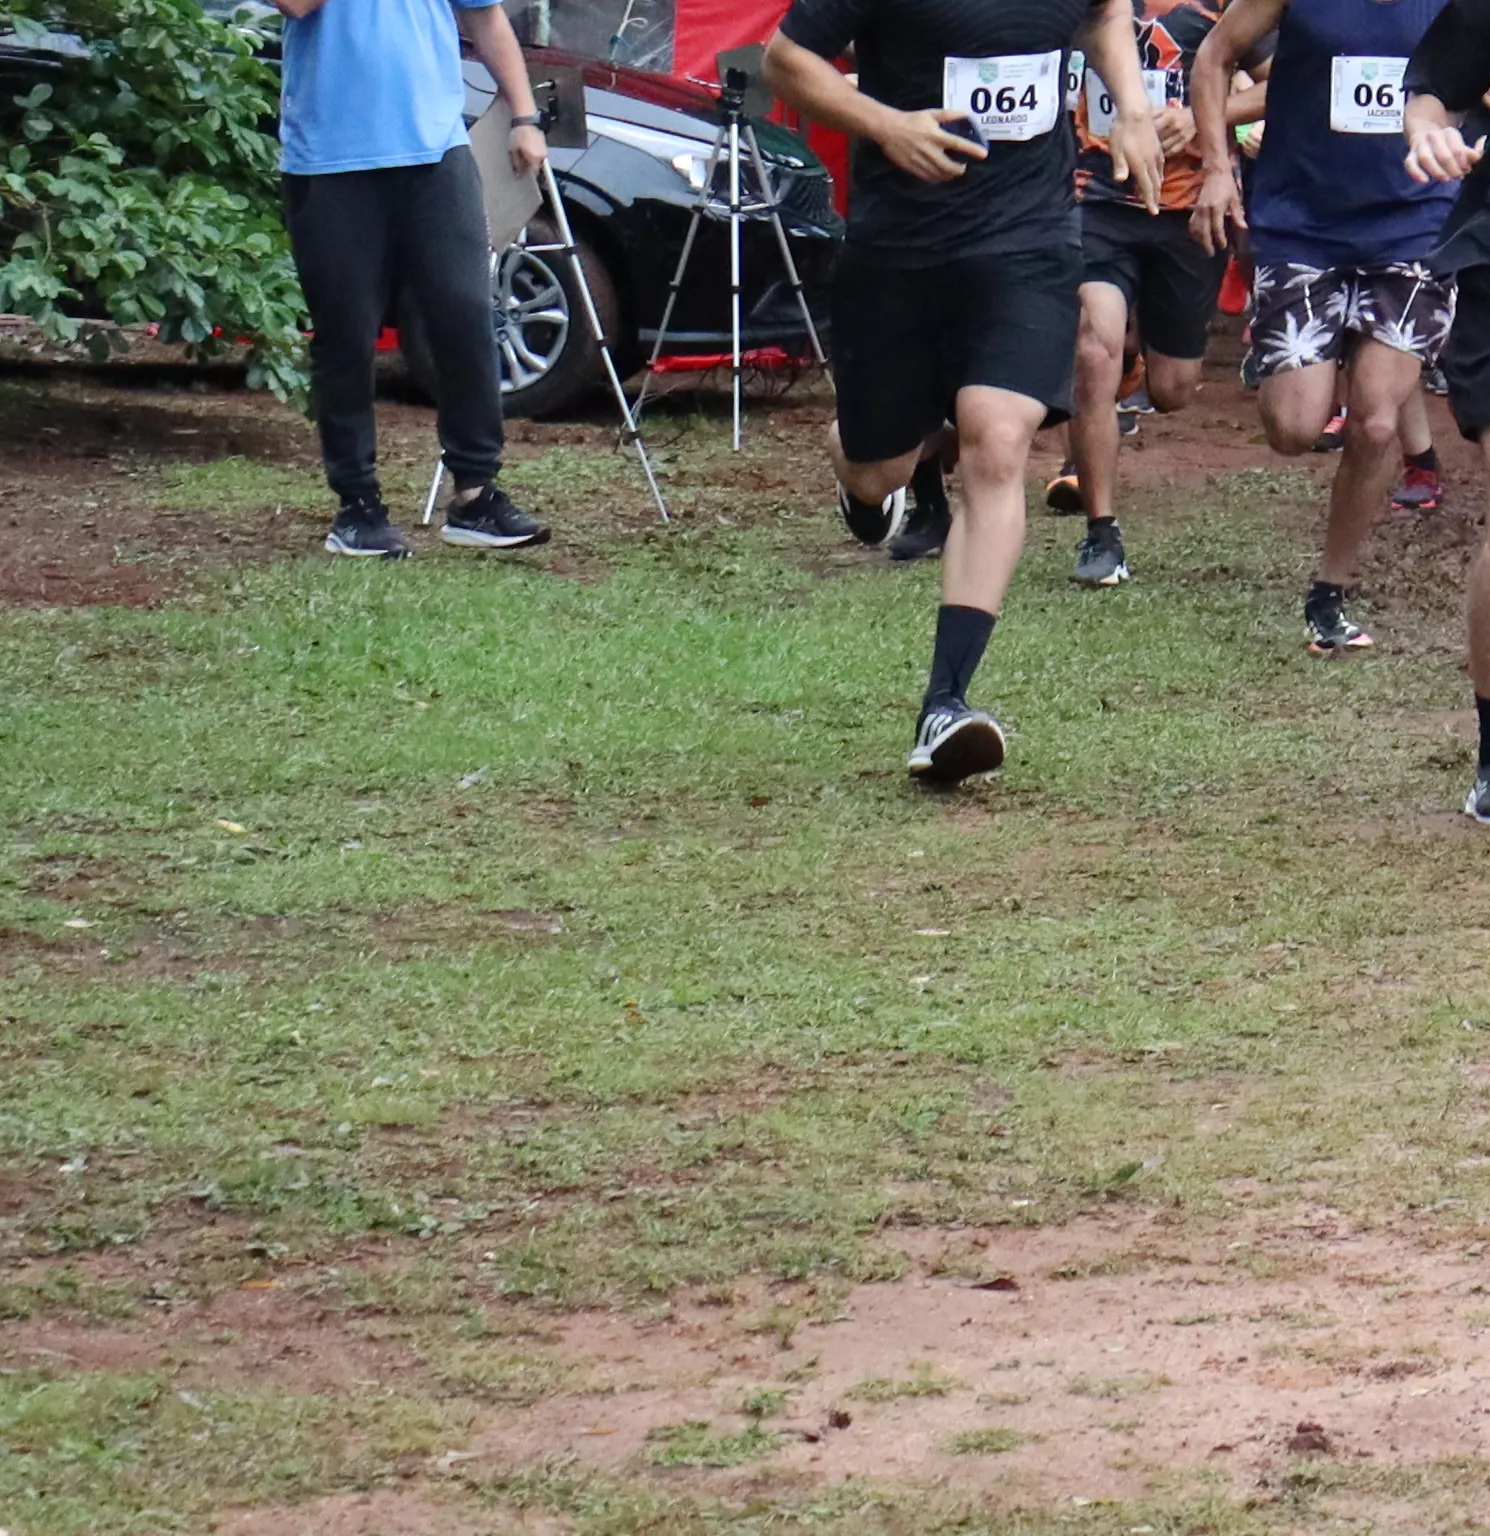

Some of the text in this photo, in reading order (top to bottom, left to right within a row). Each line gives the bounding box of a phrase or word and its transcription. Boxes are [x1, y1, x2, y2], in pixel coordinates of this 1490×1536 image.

[970, 84, 1038, 114] 064
[1354, 83, 1404, 107] 06
[981, 114, 1028, 125] LEONARDO
